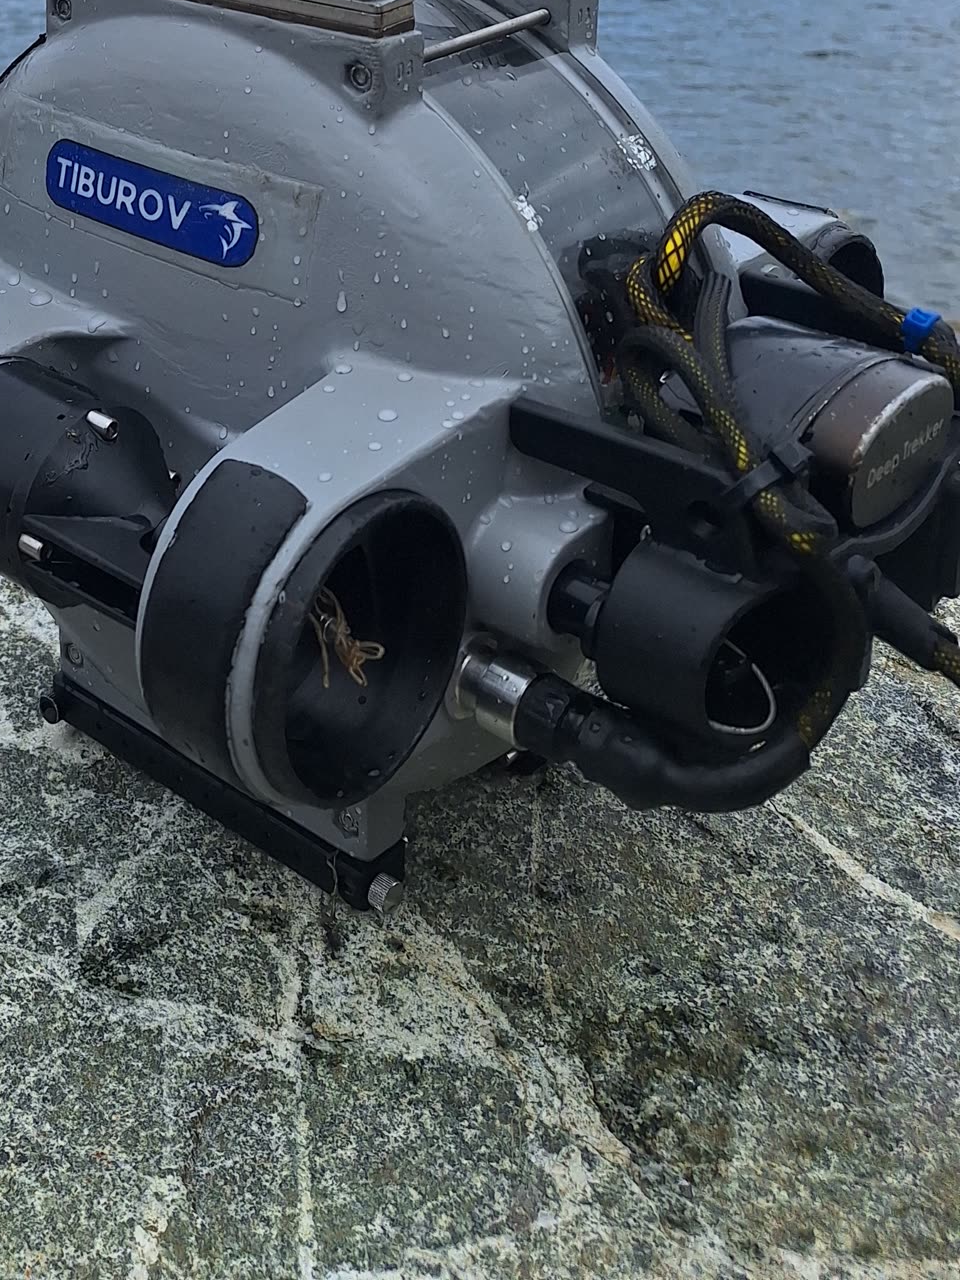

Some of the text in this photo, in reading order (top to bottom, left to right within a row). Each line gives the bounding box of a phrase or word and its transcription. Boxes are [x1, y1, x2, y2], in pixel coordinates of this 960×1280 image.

[56, 156, 192, 230] TIBUROV
[866, 418, 945, 489] Deep Trekker
